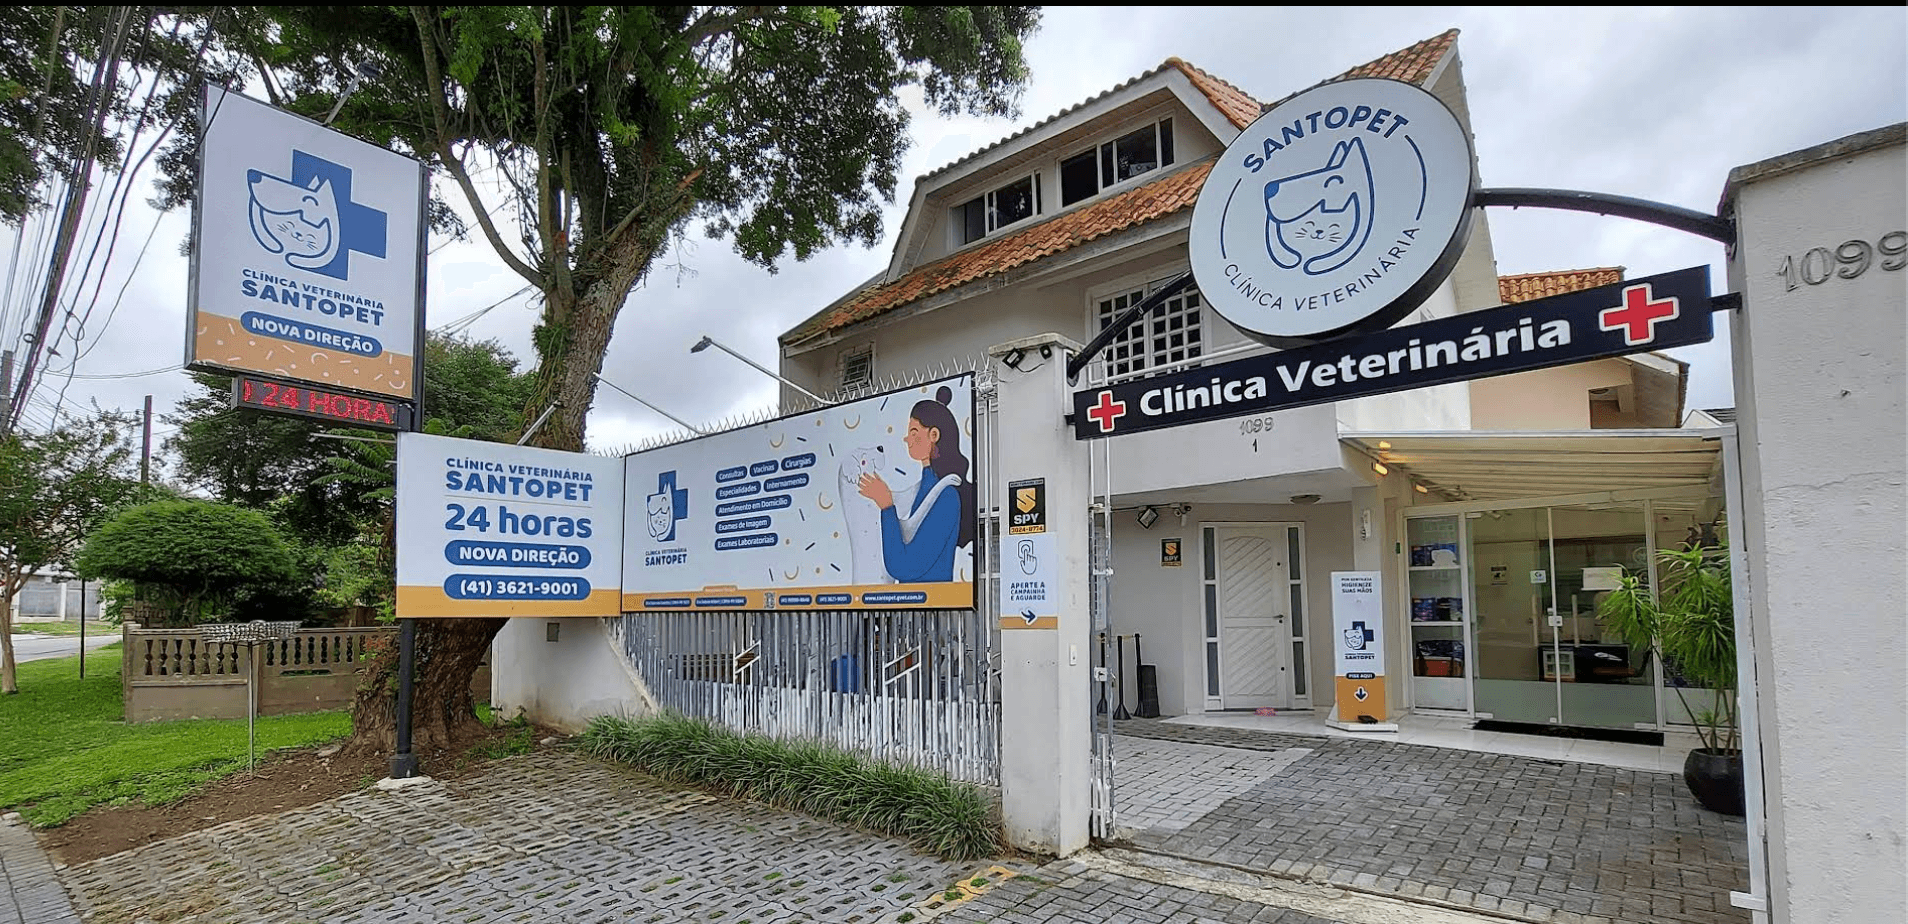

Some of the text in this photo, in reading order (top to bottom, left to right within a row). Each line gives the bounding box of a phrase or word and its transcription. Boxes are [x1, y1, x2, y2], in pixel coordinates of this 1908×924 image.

[1243, 105, 1409, 173] SANTOPET
[1224, 227, 1421, 311] CLÍNICA VETERINÁRIA
[1776, 231, 1908, 292] 1099
[242, 269, 384, 310] CLÍNICA VETERINÁRIA
[241, 279, 384, 326] SANTOPET
[252, 317, 373, 353] NOVA DIREÇÃO
[1139, 315, 1572, 418] Clínica Veterinária
[262, 382, 299, 409] 24
[1239, 417, 1274, 435] 1099
[1253, 438, 1258, 453] 1
[446, 457, 593, 482] CLÍNICA VETERINÁRIA
[719, 457, 812, 480] Consultas Vacinas Cirurgias
[446, 470, 593, 502] SANTOPET
[719, 476, 807, 498] Especialidades Internamento
[719, 502, 751, 514] Atendimento
[761, 498, 788, 508] Domicílio
[445, 503, 593, 539] 24 horas
[718, 522, 738, 531] Exames
[746, 519, 768, 530] Imagem
[1013, 512, 1040, 525] SPY
[717, 536, 775, 548] Exames Laboratoriais
[459, 546, 579, 566] NOVA DIREÇÃO
[645, 554, 687, 566] SANTOPET
[460, 579, 578, 596] (41) 3621-9001
[1011, 581, 1038, 589] APERTE
